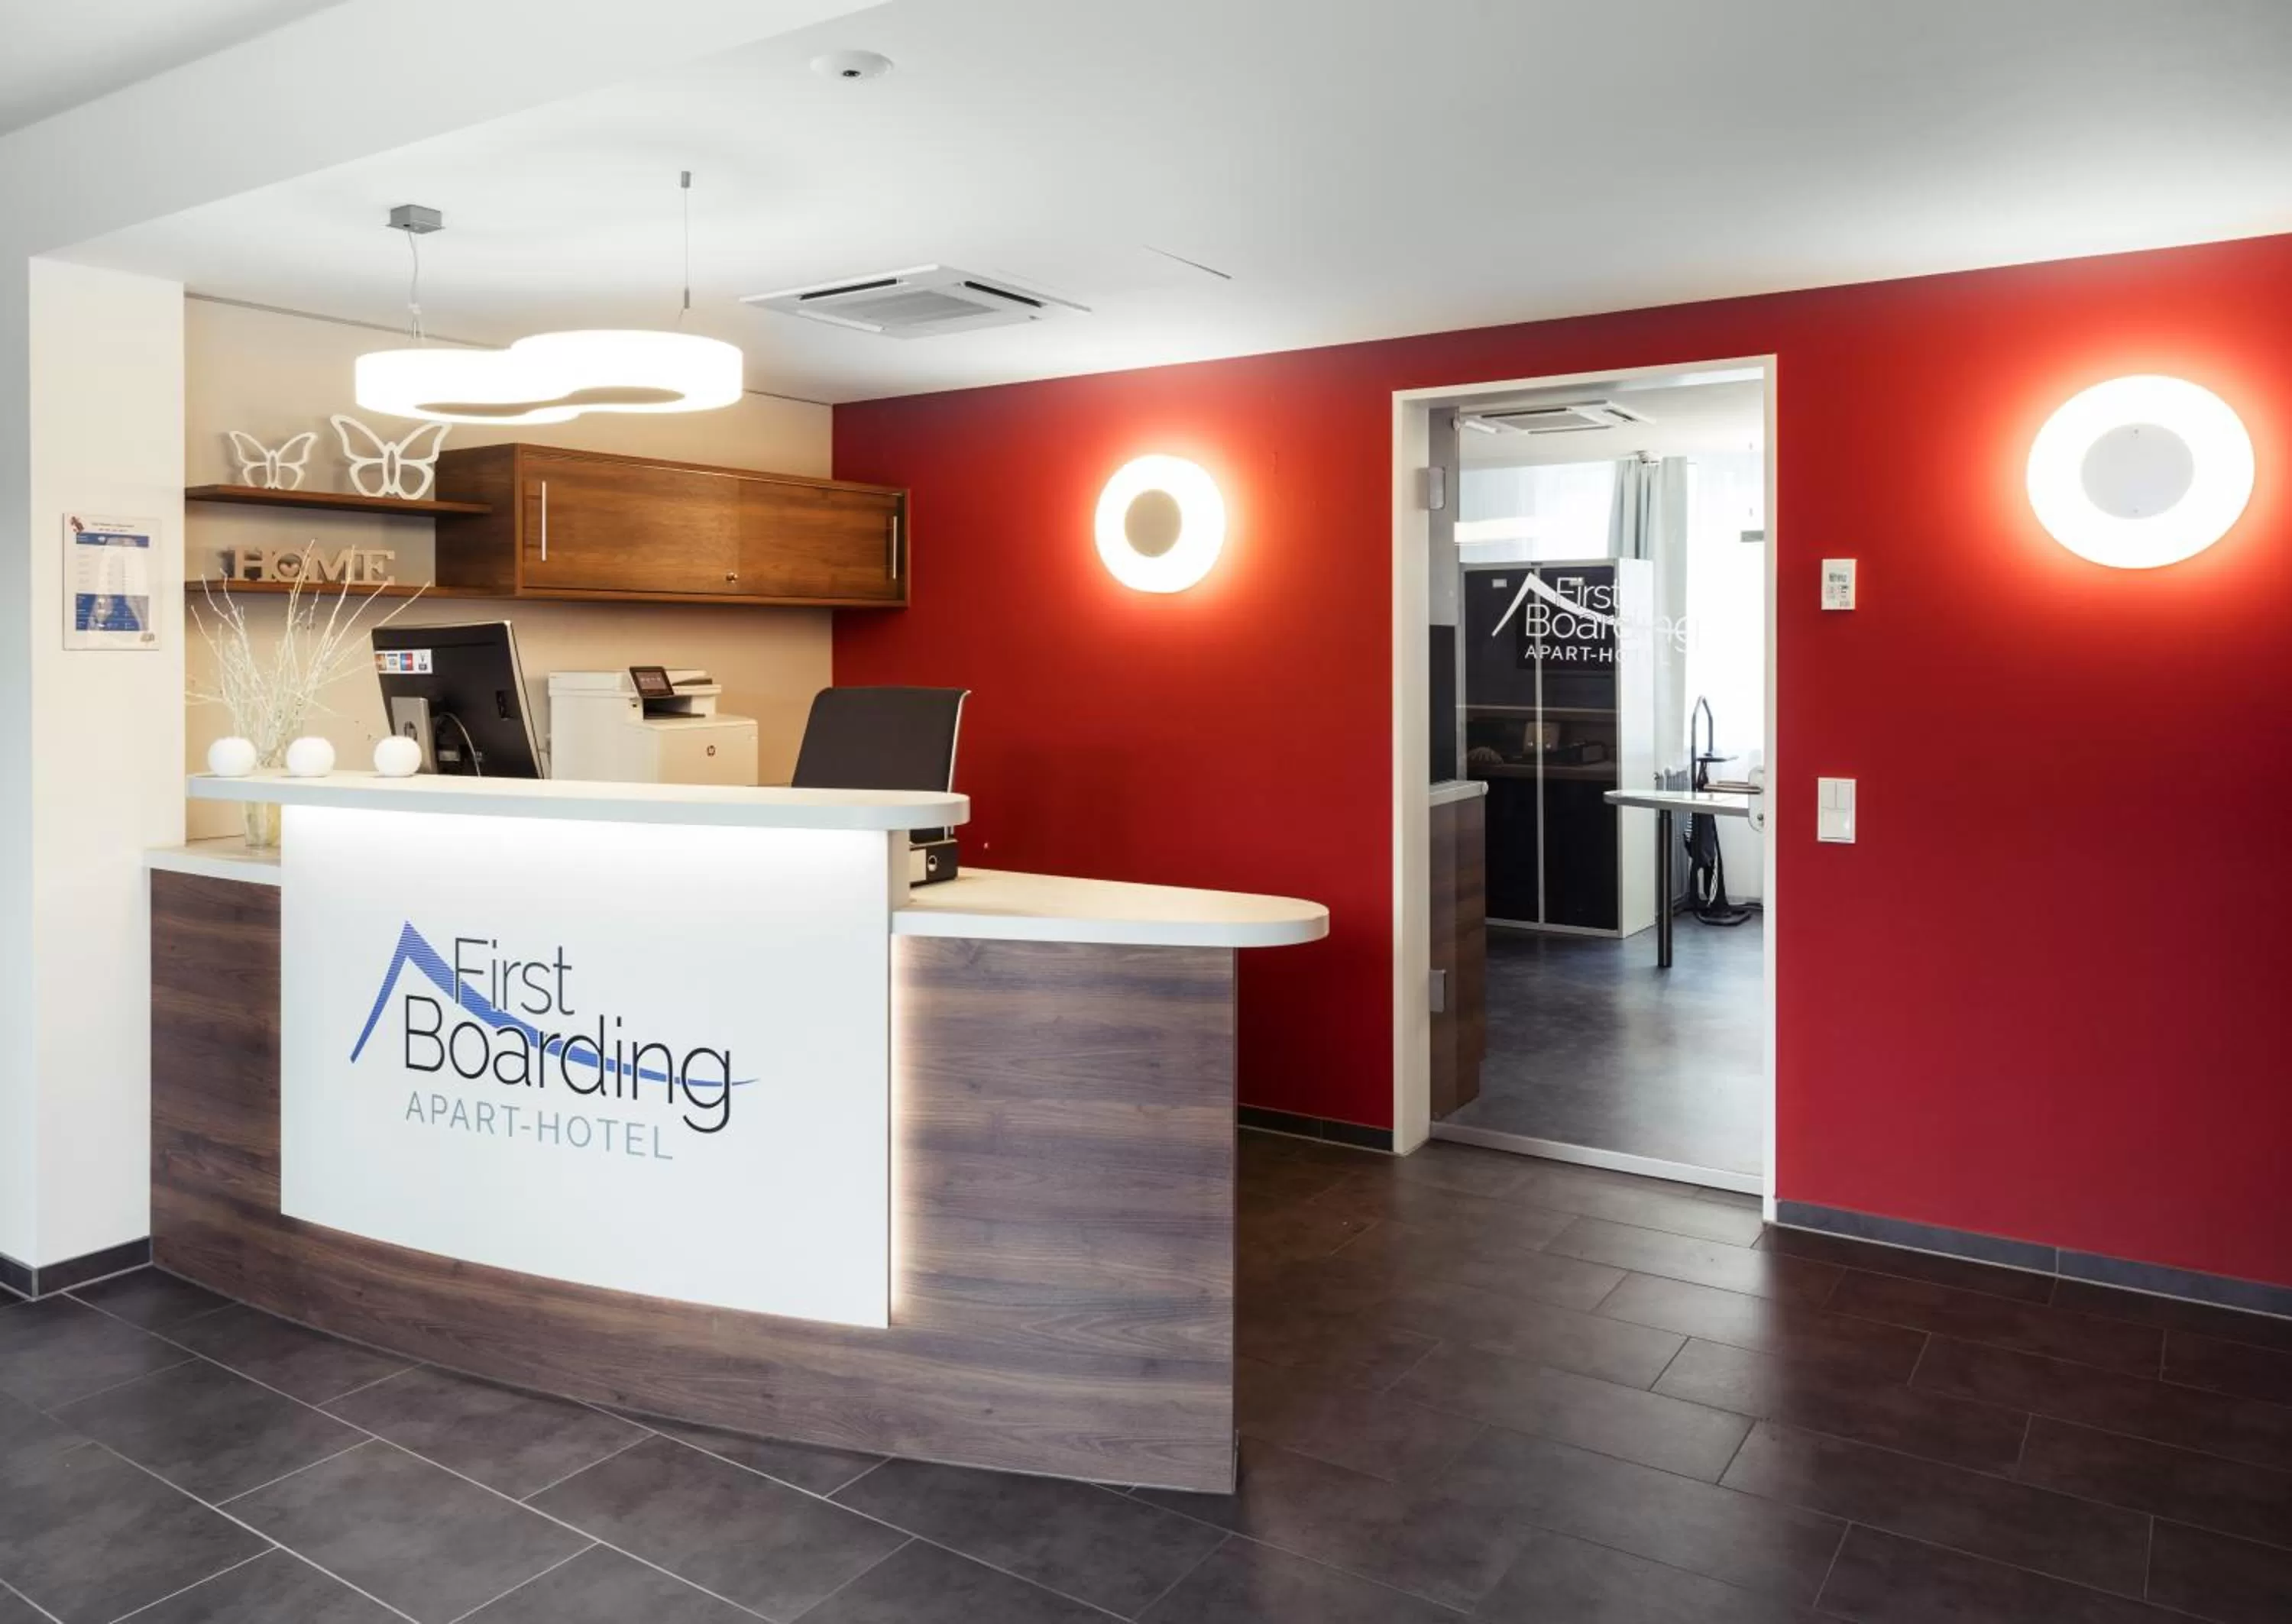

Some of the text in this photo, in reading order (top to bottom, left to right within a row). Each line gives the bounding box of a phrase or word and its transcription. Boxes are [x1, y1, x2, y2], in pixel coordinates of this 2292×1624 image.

[233, 545, 395, 585] HOME
[1557, 577, 1620, 610] First
[1526, 603, 1699, 655] Boarng
[455, 937, 575, 1016] First
[405, 994, 730, 1134] Boarding
[406, 1091, 673, 1160] APART-HOTEL
